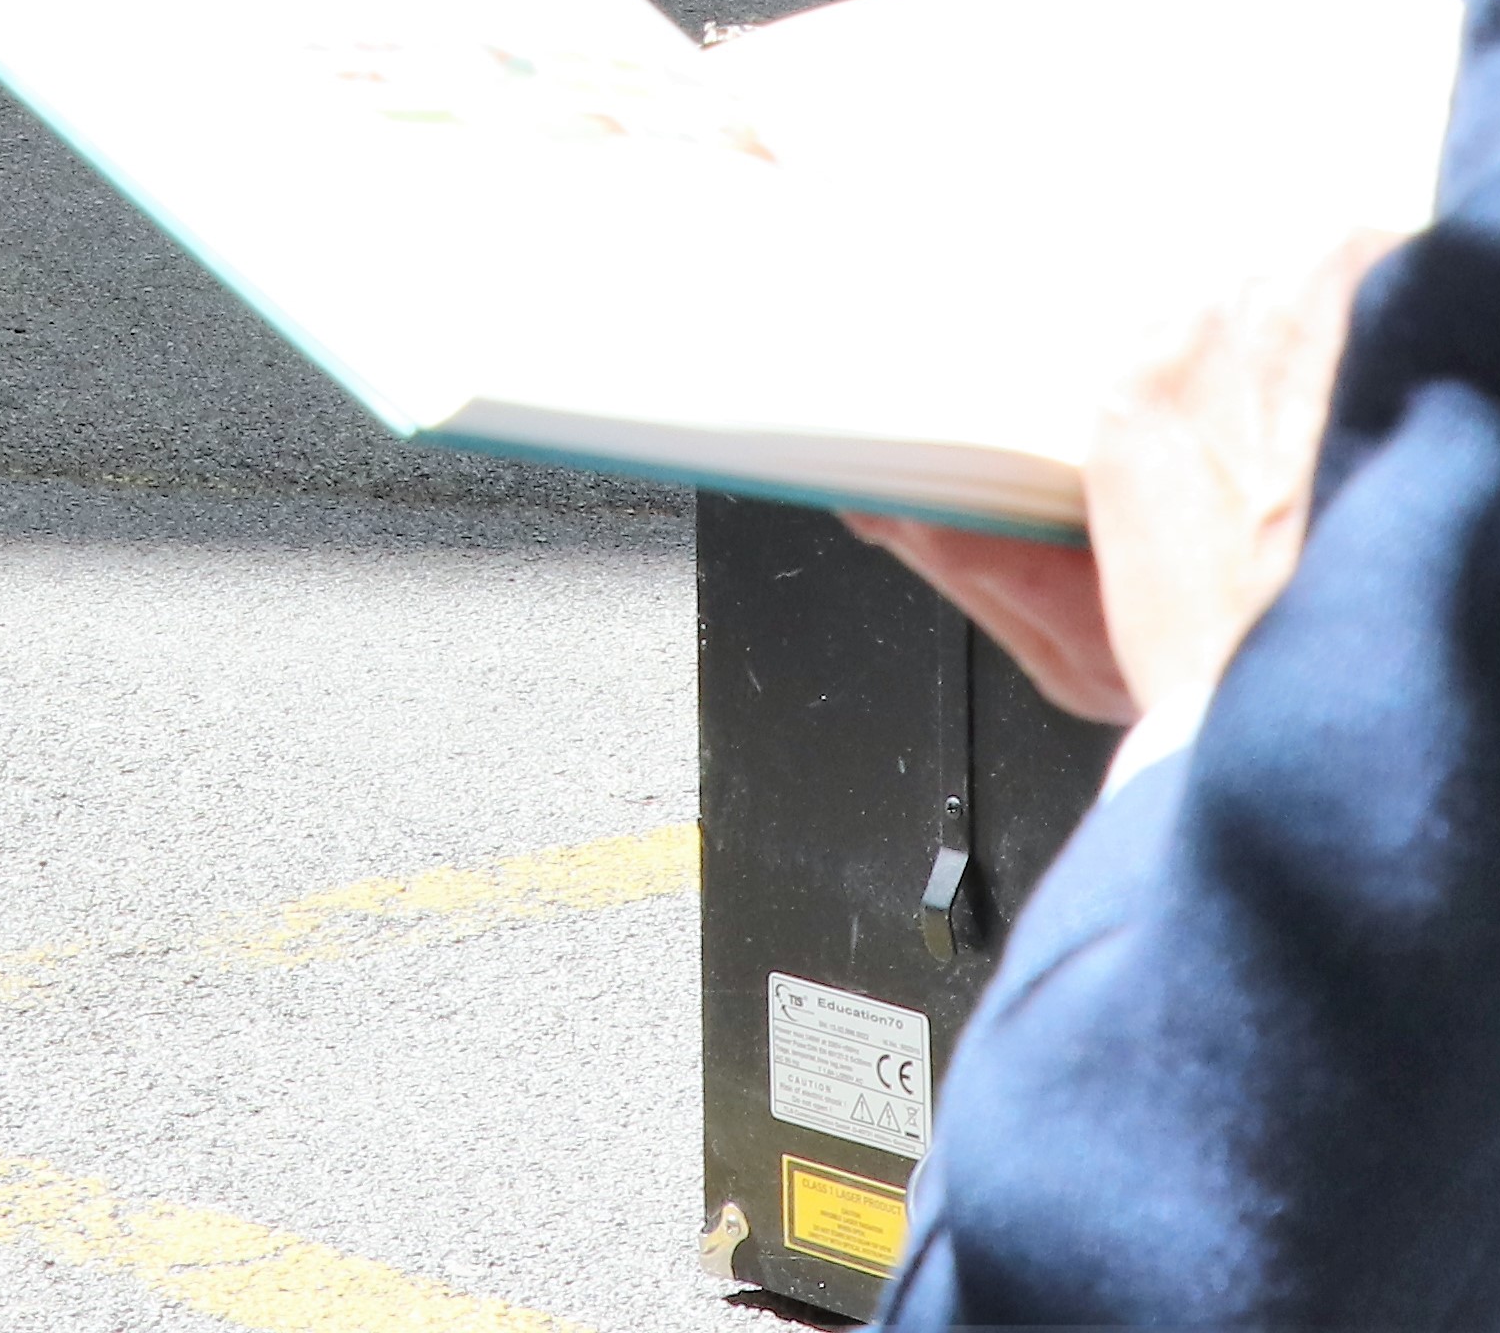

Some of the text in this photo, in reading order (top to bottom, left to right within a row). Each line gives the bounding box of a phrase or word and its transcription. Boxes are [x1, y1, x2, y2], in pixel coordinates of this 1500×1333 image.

[817, 996, 903, 1030] Education70
[786, 1073, 832, 1094] CAUTION
[801, 1177, 827, 1194] CLASS
[835, 1187, 861, 1204] LASER
[862, 1195, 901, 1216] PRODUCT
